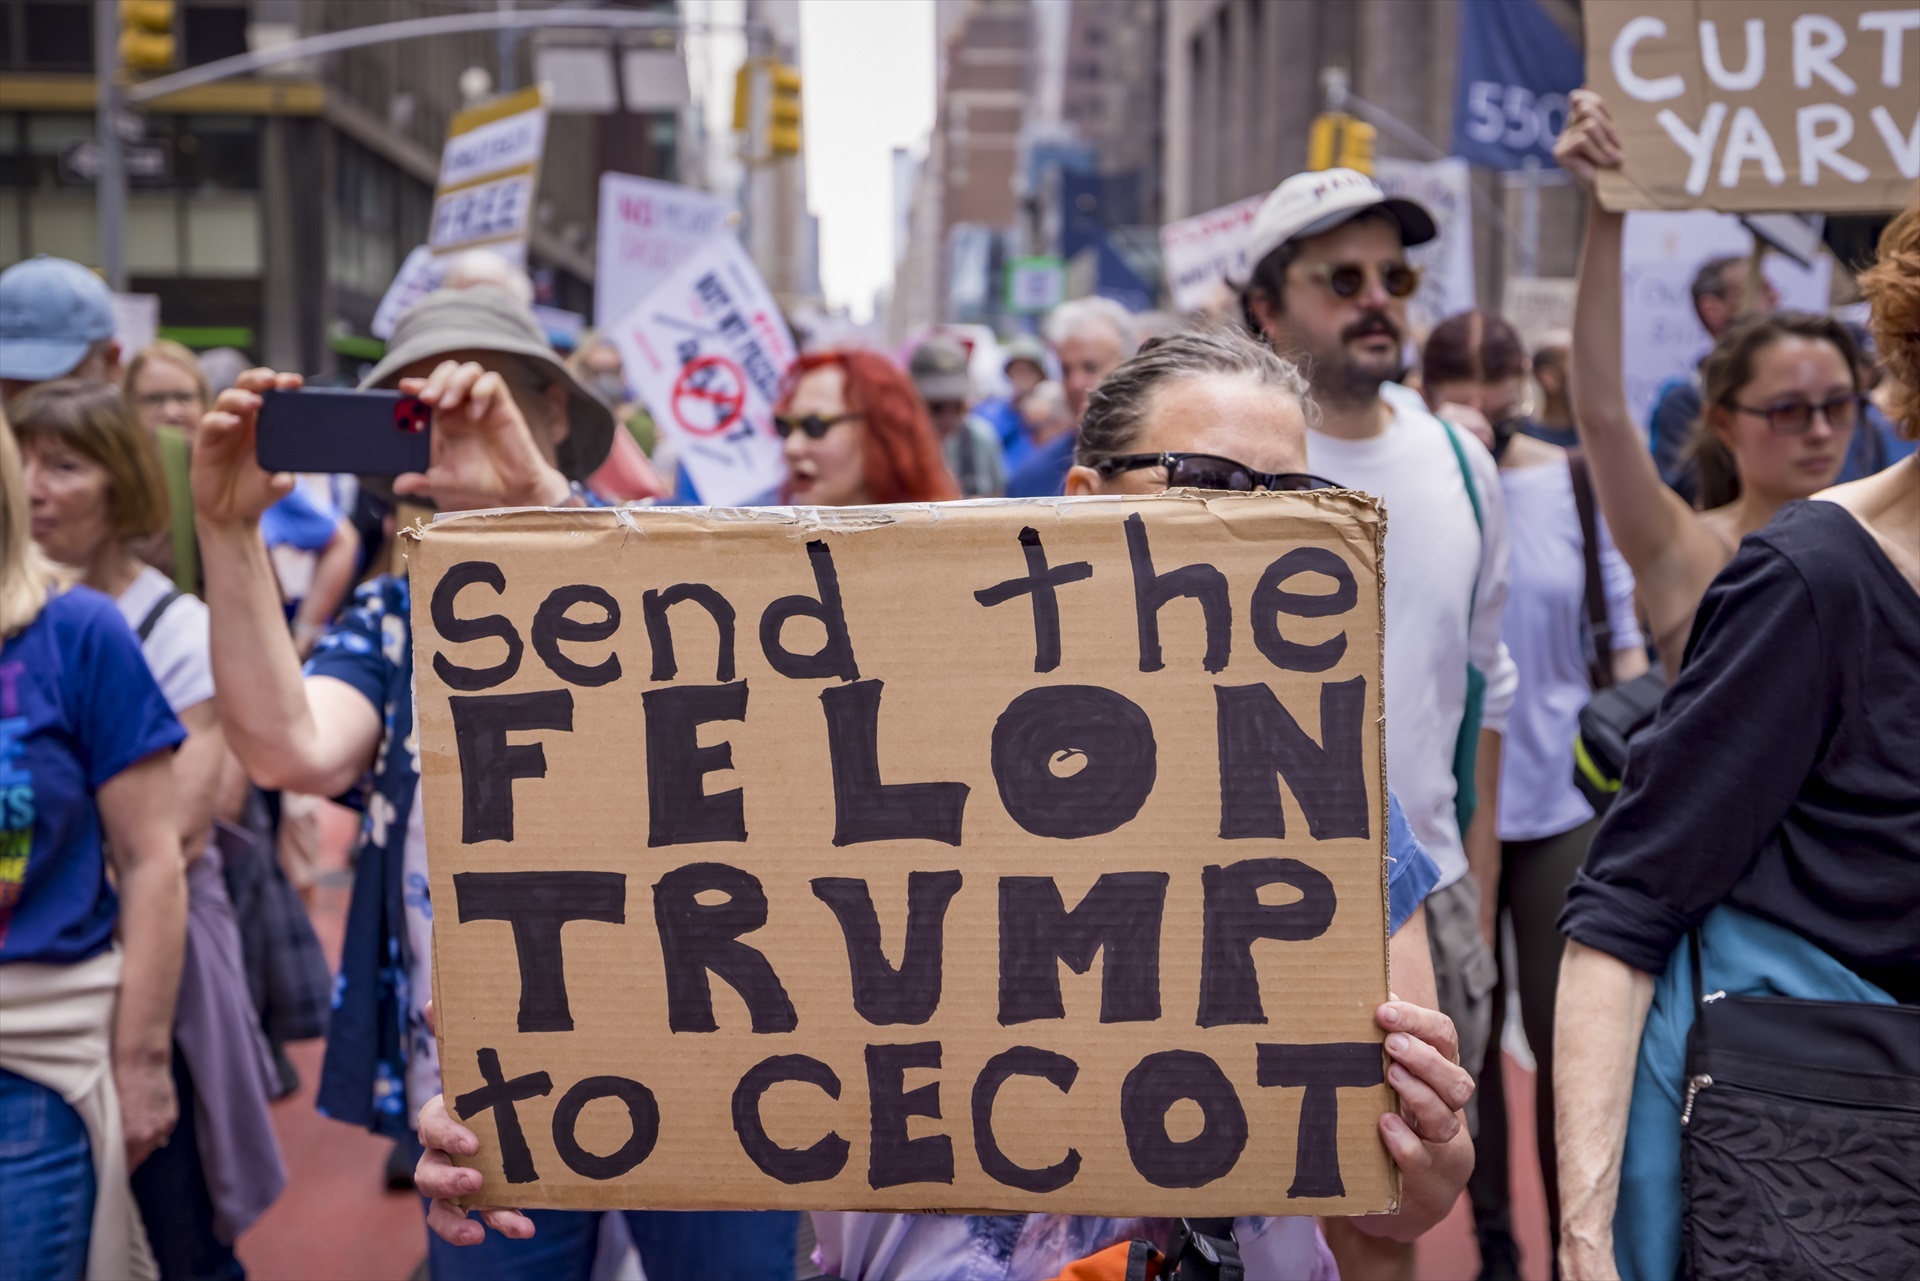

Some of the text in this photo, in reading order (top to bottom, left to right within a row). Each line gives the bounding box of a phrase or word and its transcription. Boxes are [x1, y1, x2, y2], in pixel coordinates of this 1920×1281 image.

[1465, 82, 1568, 153] 550
[1611, 9, 1920, 101] CURT
[1656, 102, 1920, 195] YARV
[431, 513, 1358, 691] Send the
[448, 675, 1370, 848] FELON
[453, 858, 1337, 1034] TRUMP
[453, 1040, 1382, 1199] to CECOT
